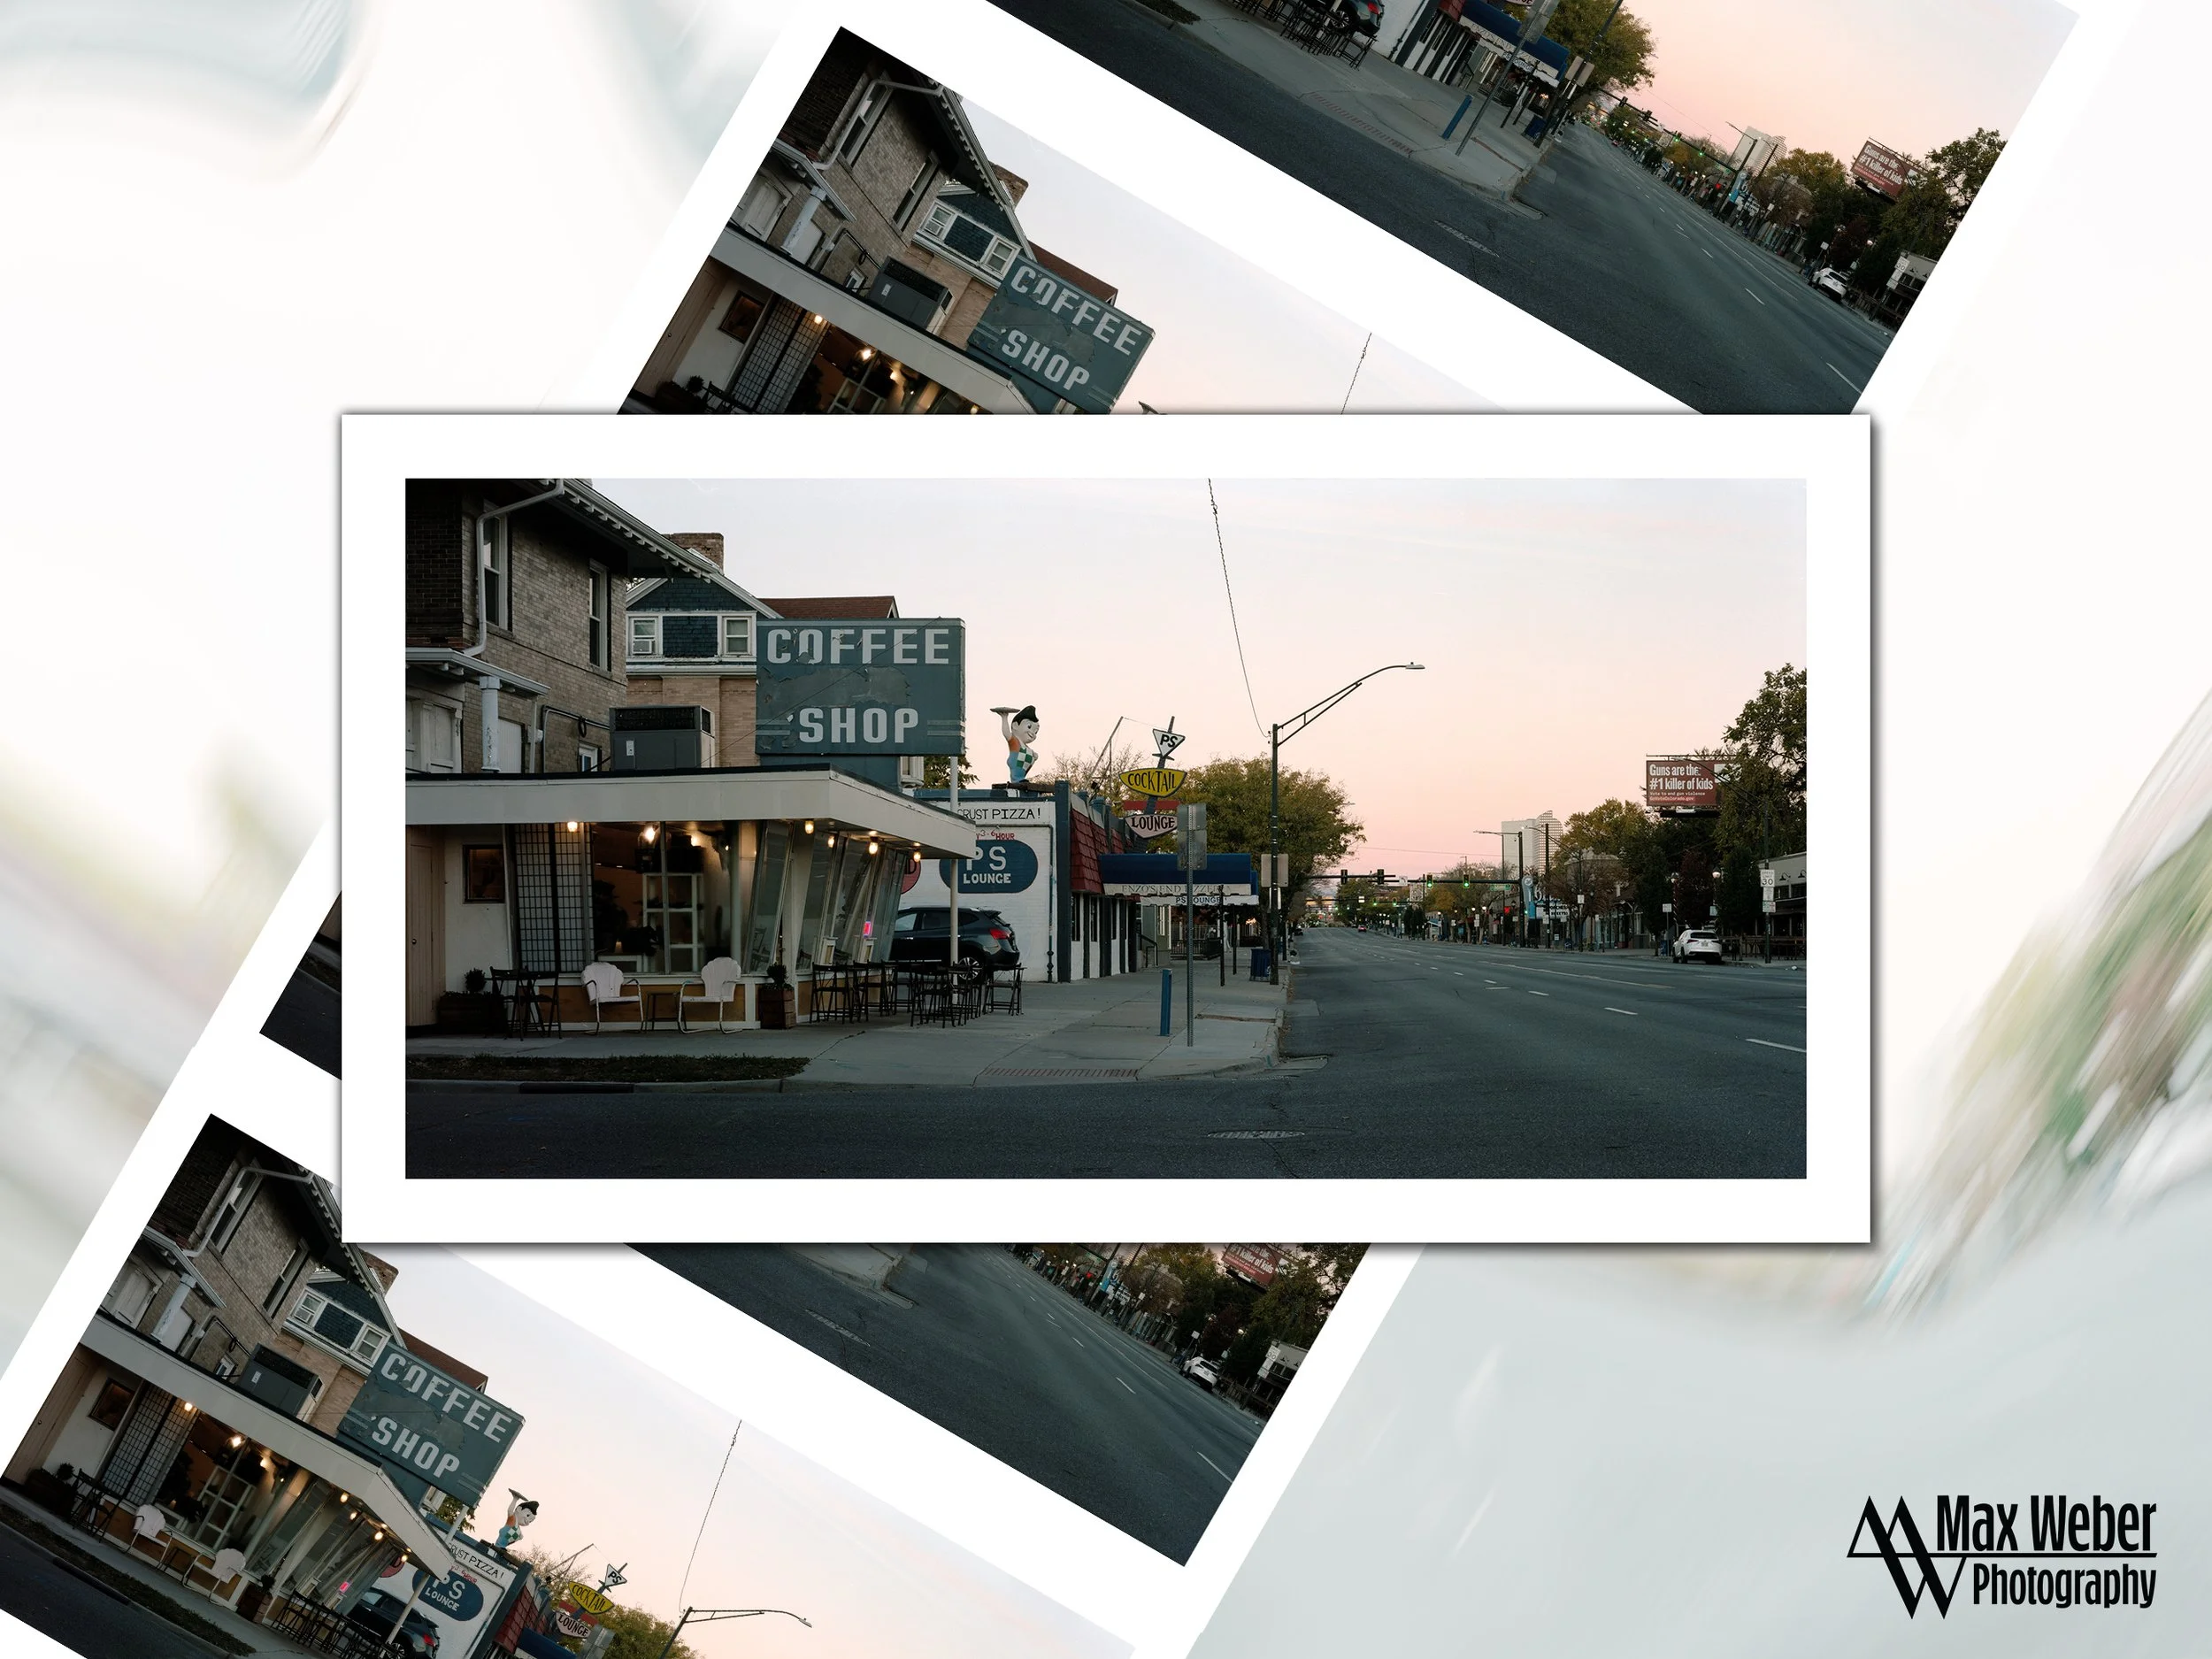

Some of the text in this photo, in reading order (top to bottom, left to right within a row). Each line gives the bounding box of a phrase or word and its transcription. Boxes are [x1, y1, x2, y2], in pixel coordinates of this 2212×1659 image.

[1512, 58, 1535, 72] OUNGE
[1883, 168, 1893, 178] of
[1010, 265, 1142, 356] COFFEE
[1002, 329, 1090, 391] SHOP
[767, 629, 949, 664] COFFEE
[799, 708, 918, 743] SHOP
[1160, 733, 1179, 749] PS
[1649, 764, 1699, 776] Guns are the
[1127, 771, 1177, 794] COCKTAIL
[1649, 778, 1714, 790] #1 killer of kids
[992, 809, 1041, 820] PIZZA!
[1131, 816, 1176, 833] LOUNGE
[964, 846, 1007, 872] PS
[963, 873, 1011, 884] LOUNGE
[1159, 885, 1181, 894] END
[1254, 1257, 1263, 1267] of
[380, 1353, 512, 1443] COFFEE
[372, 1417, 460, 1479] SHOP
[468, 1555, 504, 1579] PIZZA!
[607, 1571, 622, 1584] PS
[425, 1586, 460, 1611] LOUNGE
[432, 1575, 465, 1600] PS
[572, 1584, 606, 1611] COCKTAIL
[557, 1614, 589, 1637] LOUNGE
